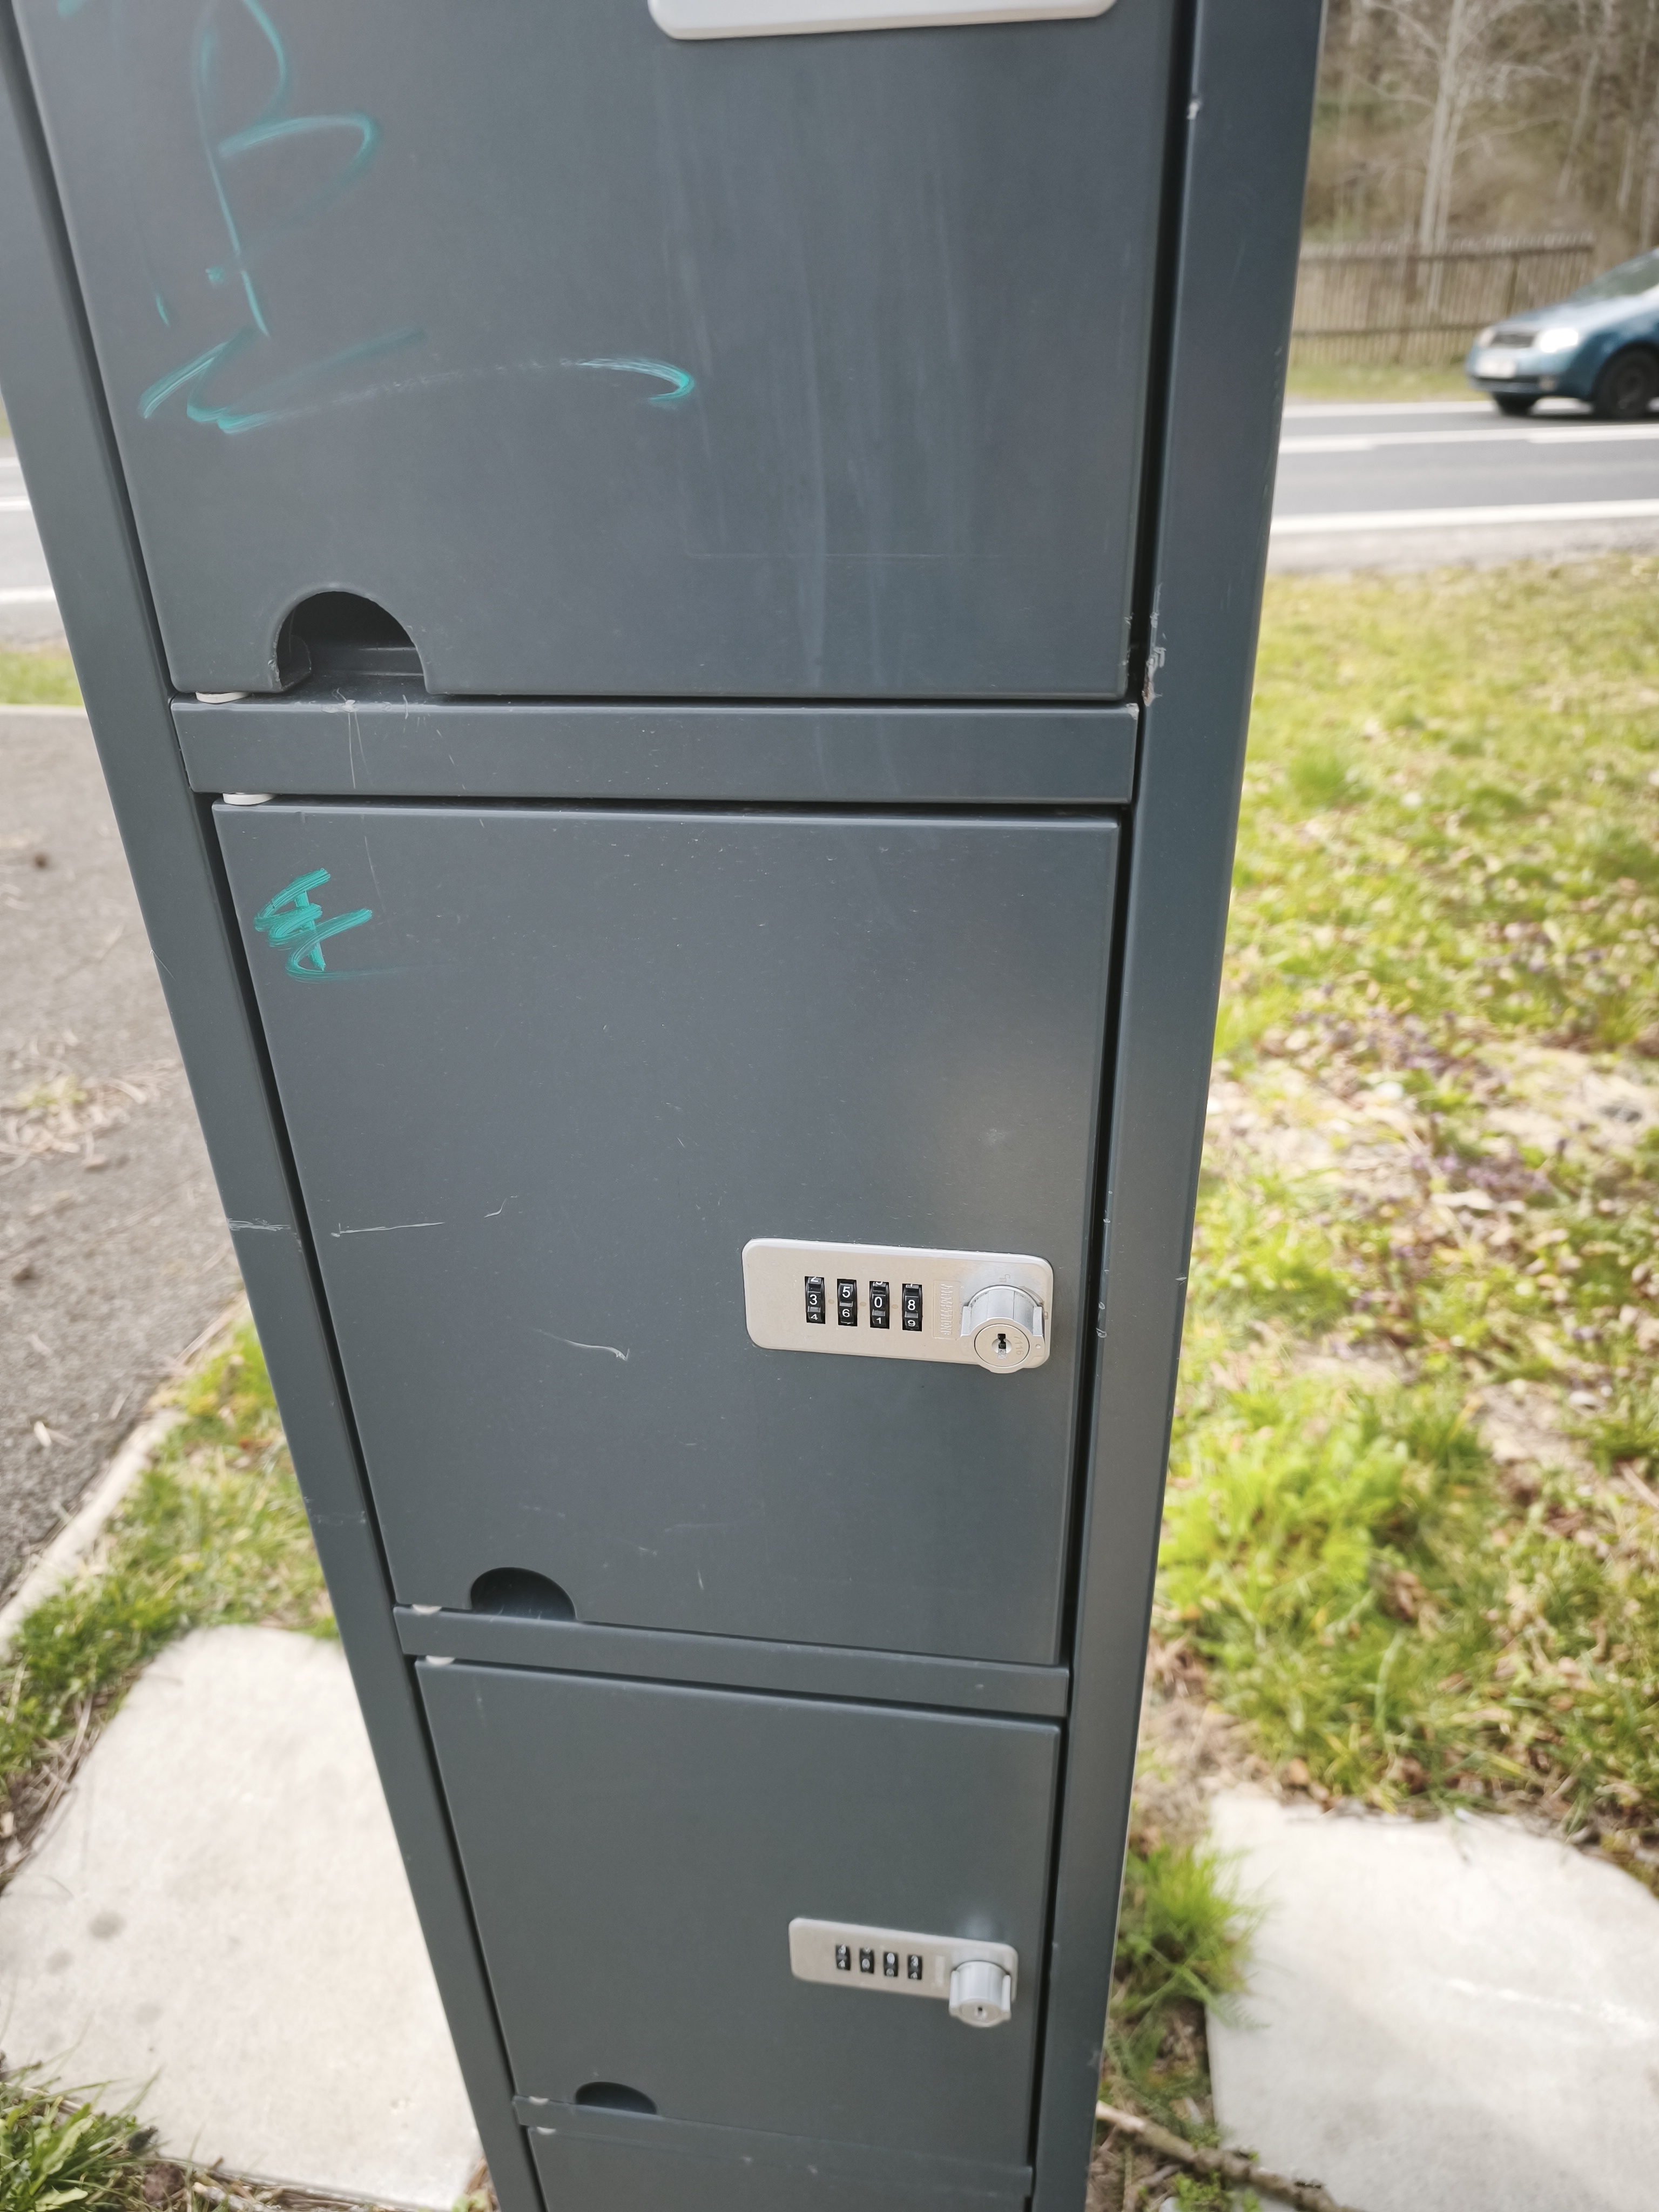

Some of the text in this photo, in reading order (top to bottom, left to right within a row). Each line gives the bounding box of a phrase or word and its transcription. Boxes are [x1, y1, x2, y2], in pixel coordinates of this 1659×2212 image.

[809, 1286, 916, 1311] 3 5 0 8
[842, 1309, 851, 1318] 6
[1013, 1335, 1024, 1355] 7116
